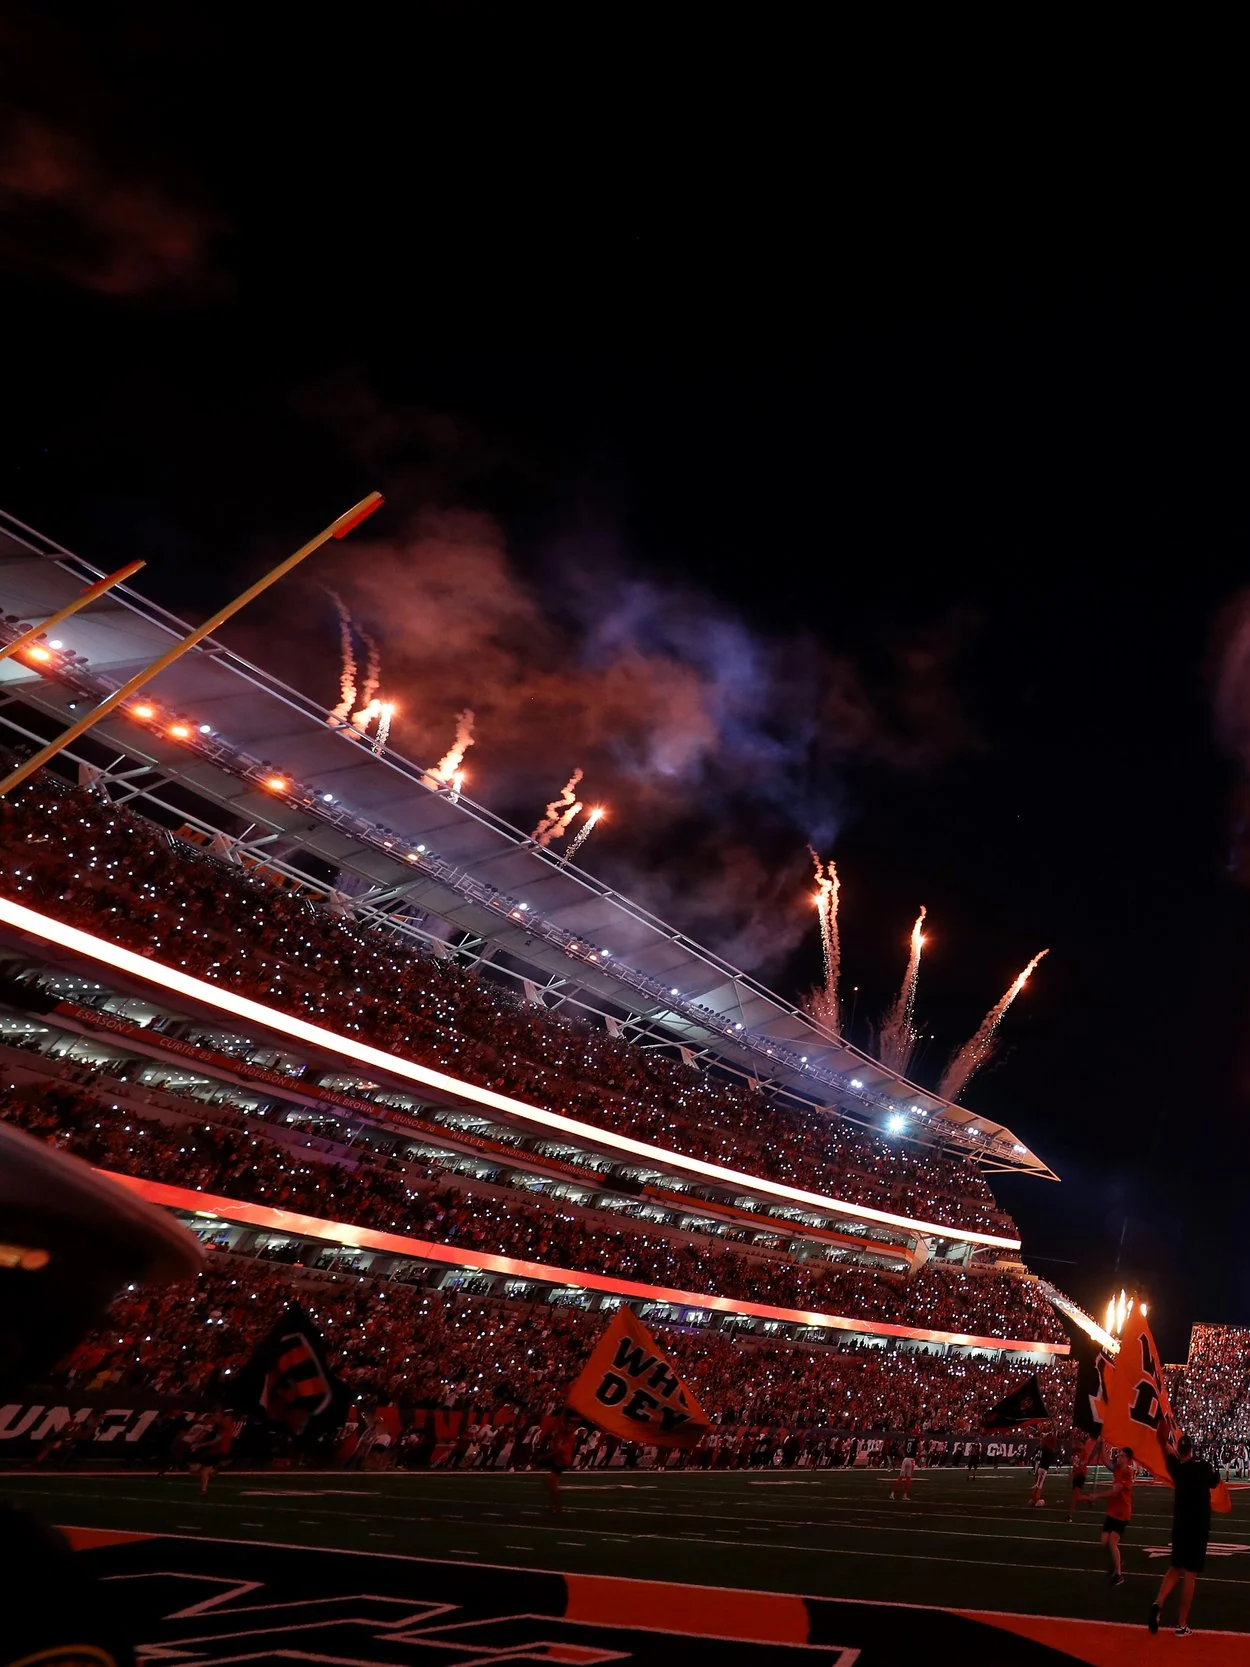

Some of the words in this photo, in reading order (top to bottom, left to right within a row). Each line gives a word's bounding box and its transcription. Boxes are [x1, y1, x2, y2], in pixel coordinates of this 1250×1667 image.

[75, 1009, 127, 1031] ESIASON
[160, 1038, 196, 1056] CURTIS
[234, 1064, 287, 1085] ANDERSON
[319, 1089, 341, 1104] PAUL
[343, 1099, 375, 1113] BROWN
[451, 1132, 475, 1144] RILEY
[500, 1147, 538, 1162] ANDERSON
[560, 1164, 589, 1177] JOHNSON
[611, 1336, 690, 1409] WH
[595, 1372, 690, 1432] DEY
